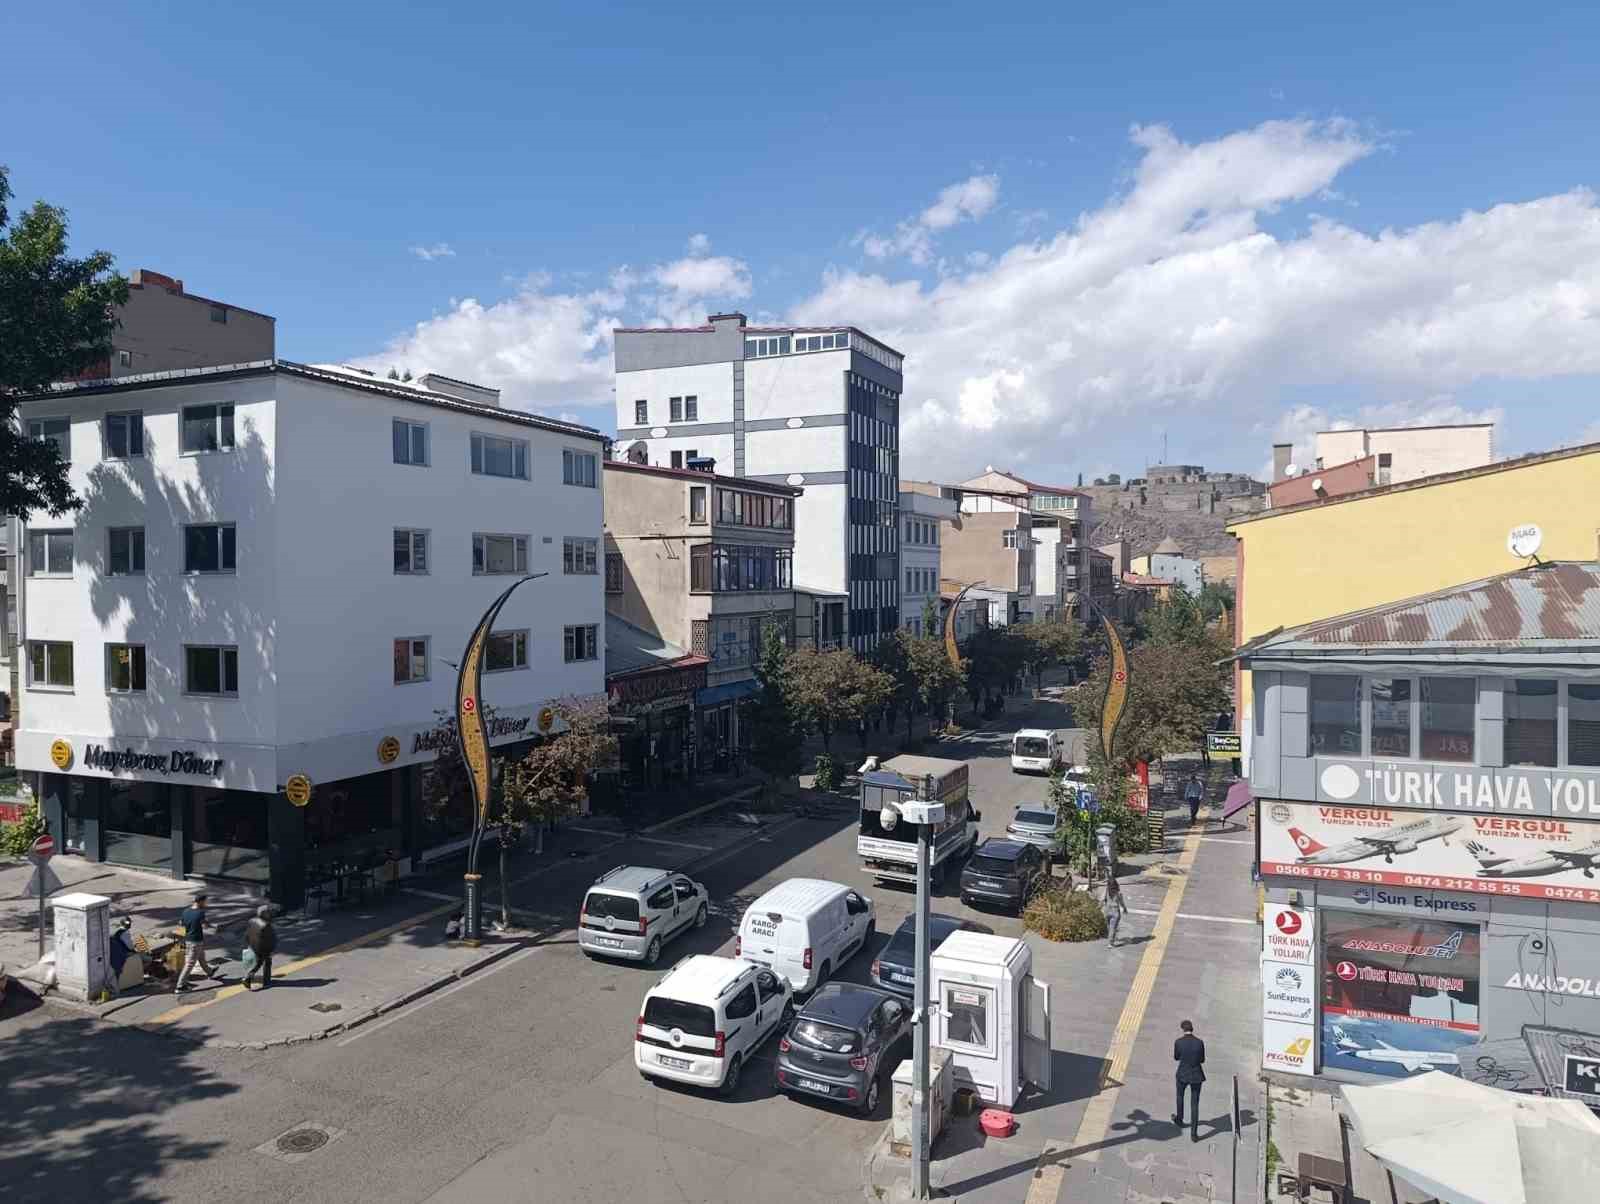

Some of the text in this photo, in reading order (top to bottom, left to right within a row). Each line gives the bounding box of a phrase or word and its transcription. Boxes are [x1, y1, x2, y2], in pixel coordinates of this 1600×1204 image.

[171, 749, 224, 776] Döner
[1364, 763, 1600, 817] TÜRK HAVA YOL
[1275, 864, 1383, 882] 0506 875 38 10
[1404, 874, 1521, 895] 0474 212 55 55
[1544, 886, 1584, 899] 0474
[1377, 891, 1477, 912] Sun Express
[752, 919, 778, 930] KARGO
[752, 928, 775, 937] ARACI
[1268, 934, 1311, 947] TÜRK HAVA
[1358, 965, 1464, 992] TÜRK HAVA YOLLARI
[1267, 991, 1311, 1004] SunExpress
